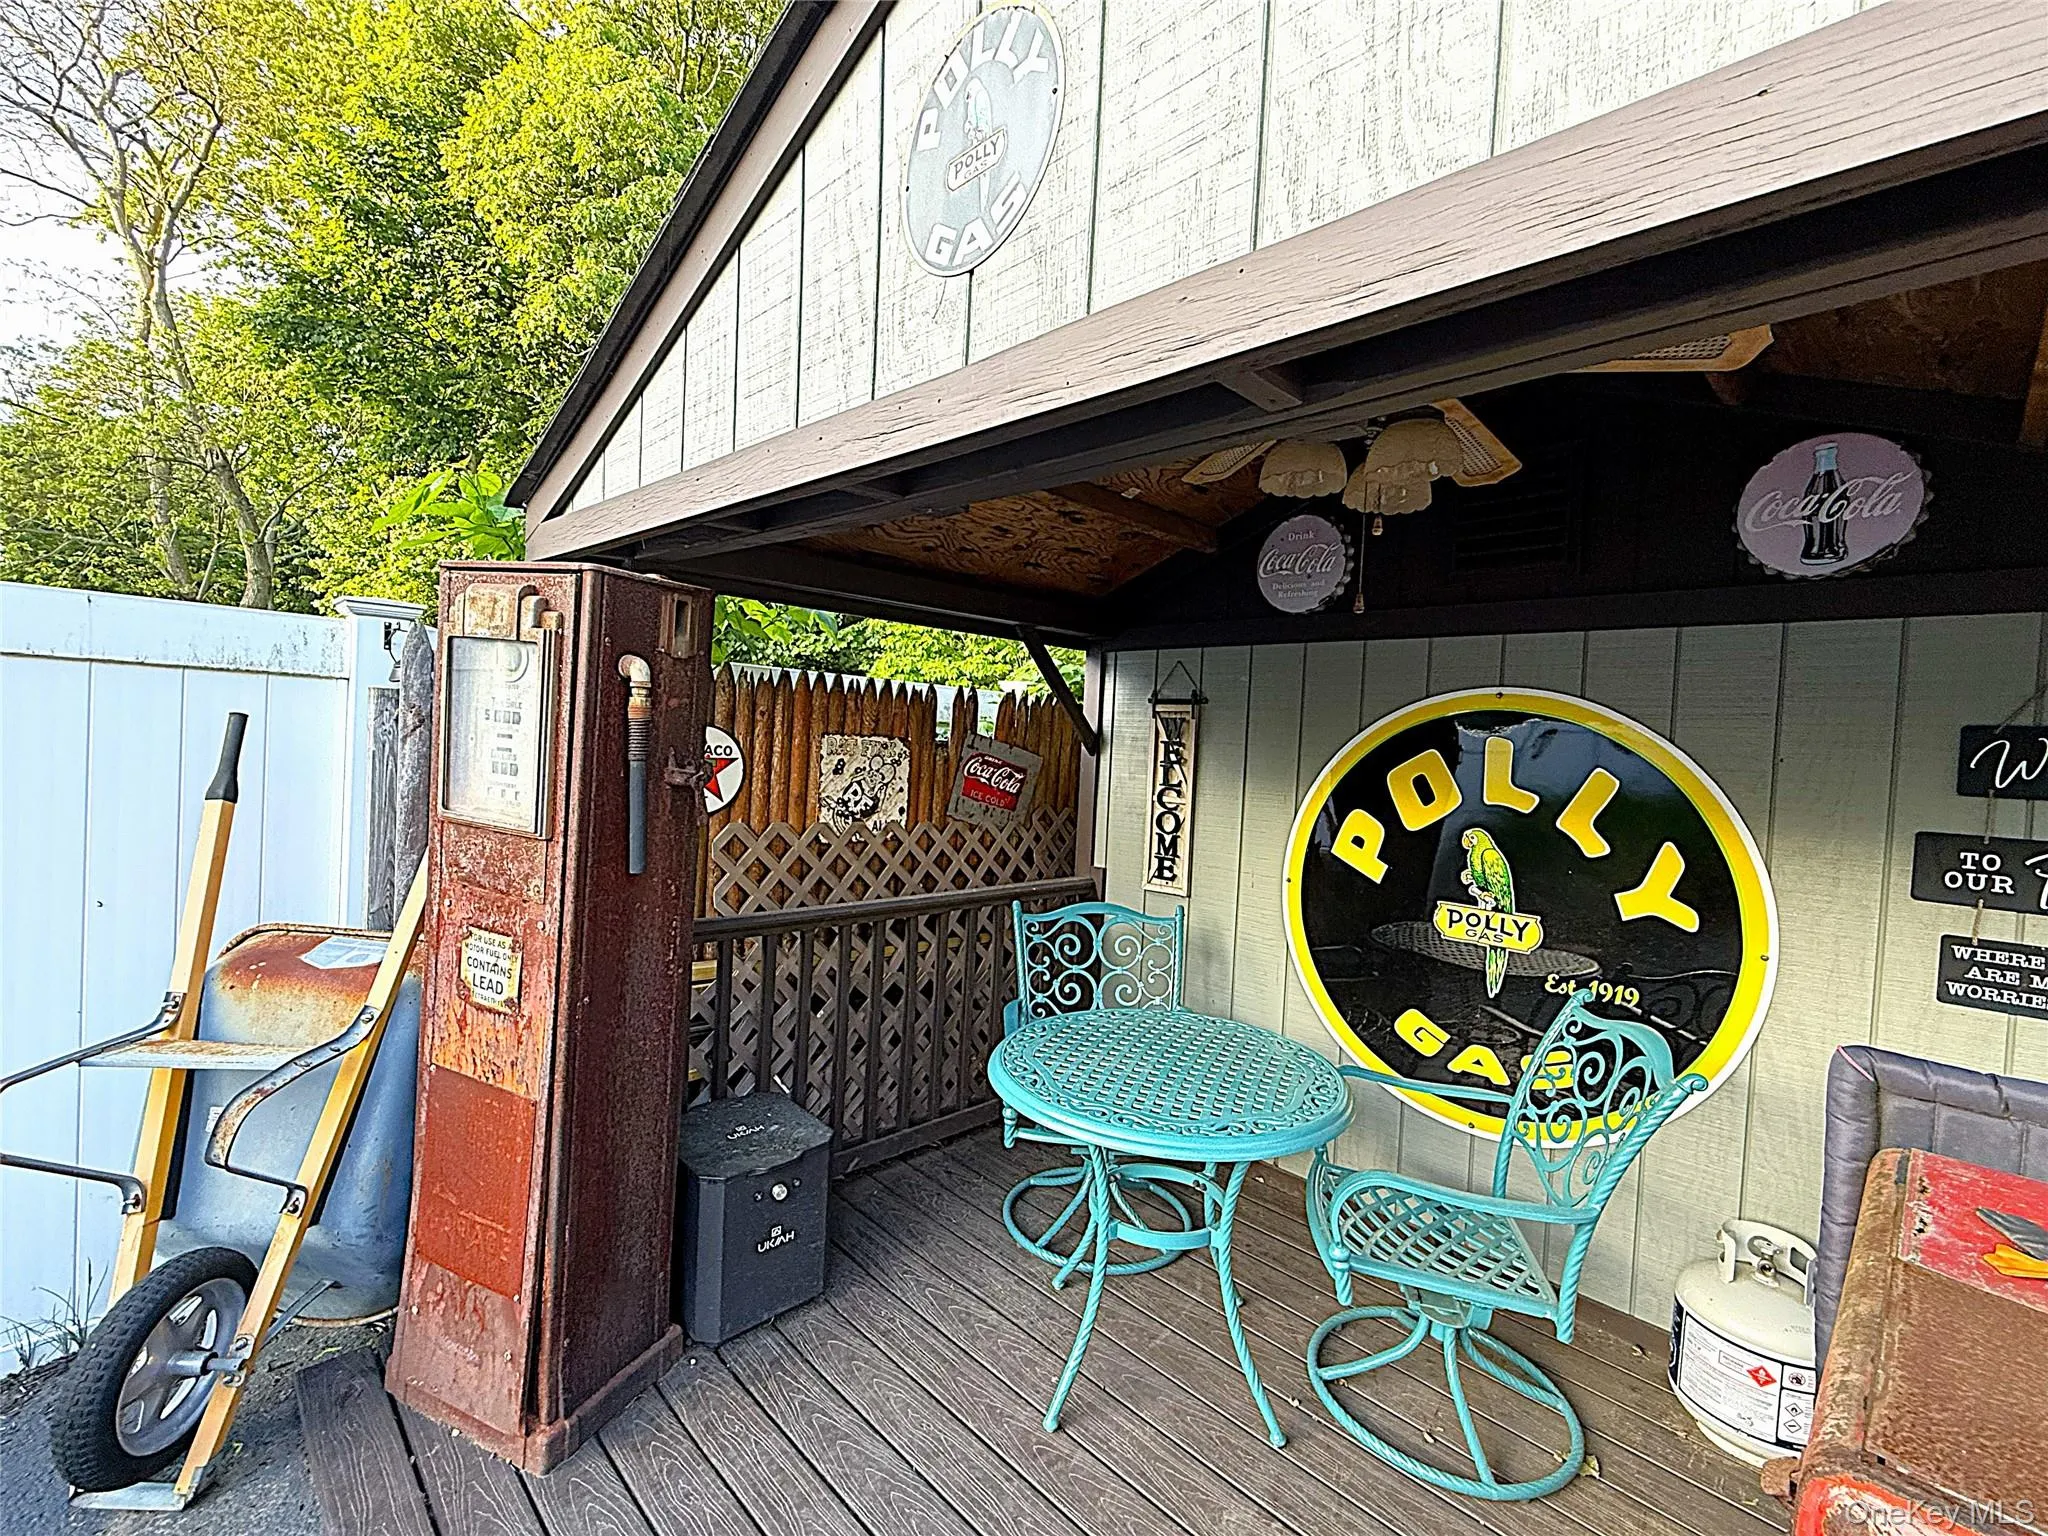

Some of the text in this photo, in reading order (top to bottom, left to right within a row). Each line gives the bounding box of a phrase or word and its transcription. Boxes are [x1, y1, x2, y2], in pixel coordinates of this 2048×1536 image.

[916, 11, 1049, 151] POLLY
[954, 138, 1000, 179] POLLY
[963, 160, 987, 179] GAS
[924, 170, 1029, 266] GAS
[1288, 531, 1315, 541] Drink
[705, 744, 733, 757] ACO
[970, 789, 1006, 807] ICE COLD
[1154, 717, 1187, 882] WELCOME
[1331, 736, 1700, 933] POLLY
[1960, 851, 2002, 872] TO
[1944, 870, 2015, 895] OUR
[1446, 908, 1531, 943] POLLY
[1465, 928, 1504, 944] GAS
[464, 942, 484, 955] MOTOR
[486, 948, 502, 959] FUEL
[483, 937, 496, 947] USE
[497, 940, 506, 950] AS
[467, 956, 513, 979] CONTAINS
[1950, 944, 2046, 970] WHERE
[472, 973, 504, 995] LEAD
[1963, 966, 2021, 986] ARE
[1588, 980, 1640, 1008] 1919
[1945, 981, 2048, 1011] WORRIE
[1394, 1008, 1574, 1091] GAS
